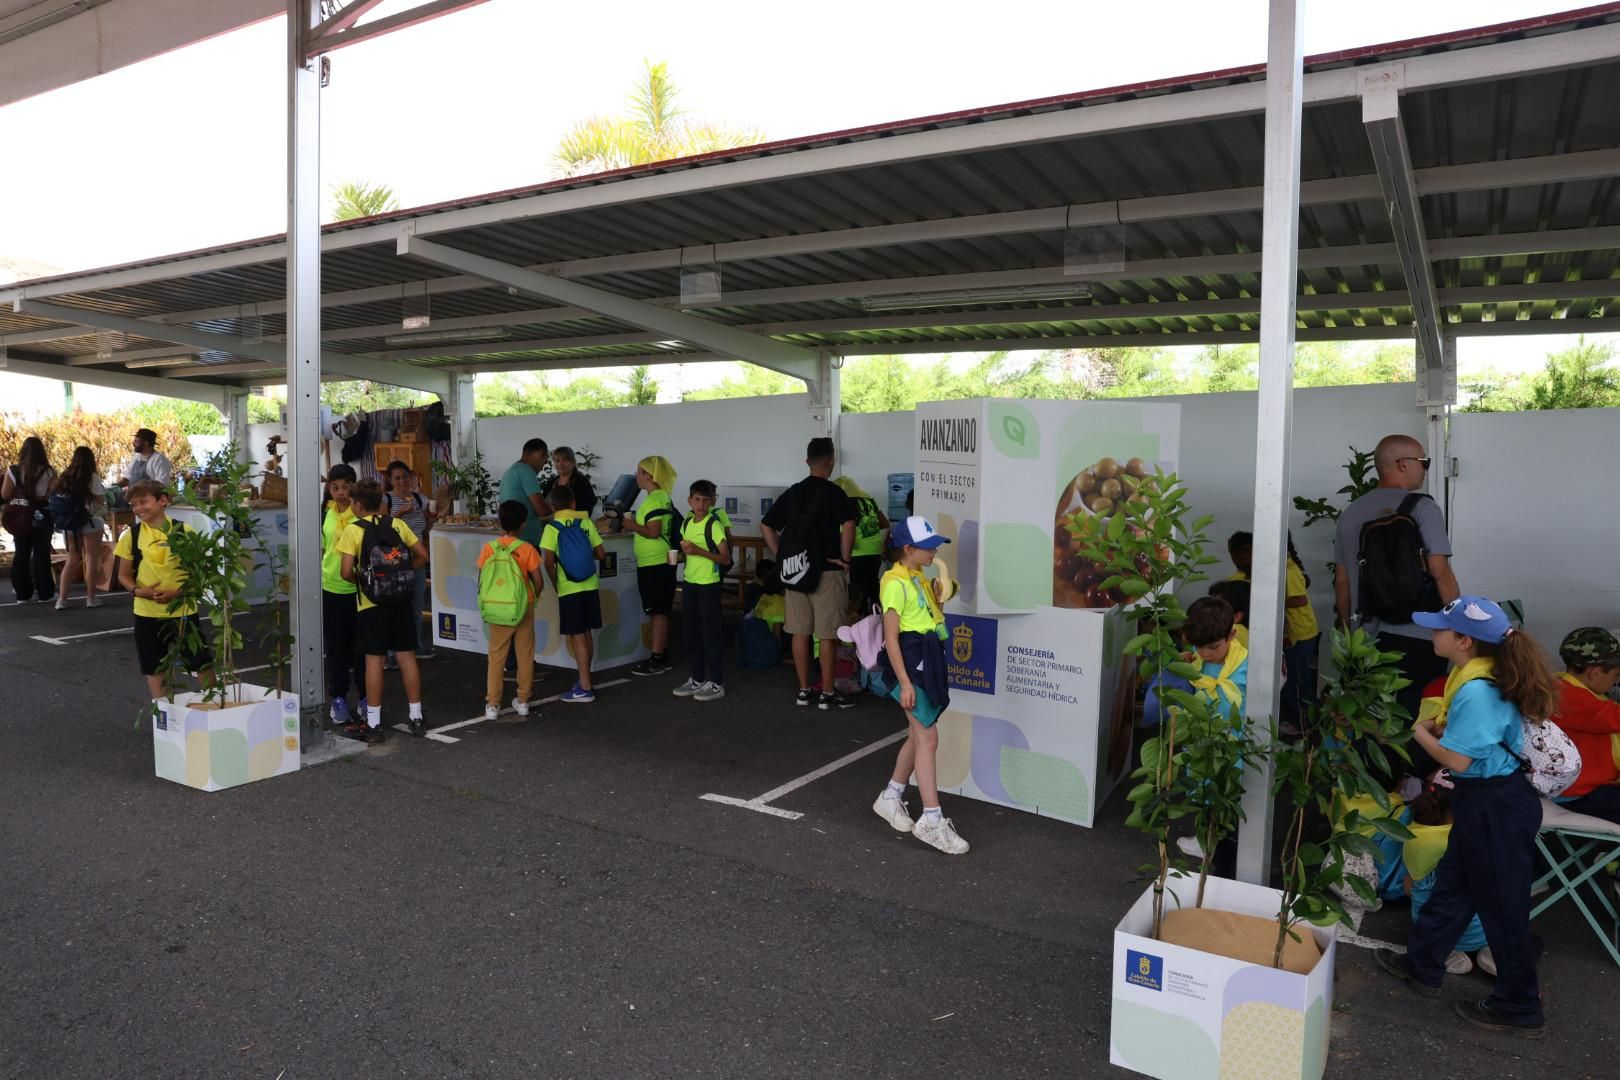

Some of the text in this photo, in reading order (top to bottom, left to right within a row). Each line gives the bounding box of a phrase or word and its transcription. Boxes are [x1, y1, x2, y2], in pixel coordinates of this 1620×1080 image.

[920, 417, 976, 453] AVANZANDO
[920, 472, 976, 488] CON EL SECTOR
[931, 488, 966, 504] PRIMARIO
[782, 549, 811, 576] NIKE
[1007, 645, 1055, 660] CONSEJERÍA
[947, 663, 984, 678] bildo de
[1006, 665, 1047, 678] SOBERANÍA
[1007, 655, 1084, 676] DE SECTOR PRIMARIO,
[956, 675, 990, 689] Canaria
[1055, 683, 1060, 691] Y
[1006, 685, 1078, 705] SEGURIDAD HÍDRICA
